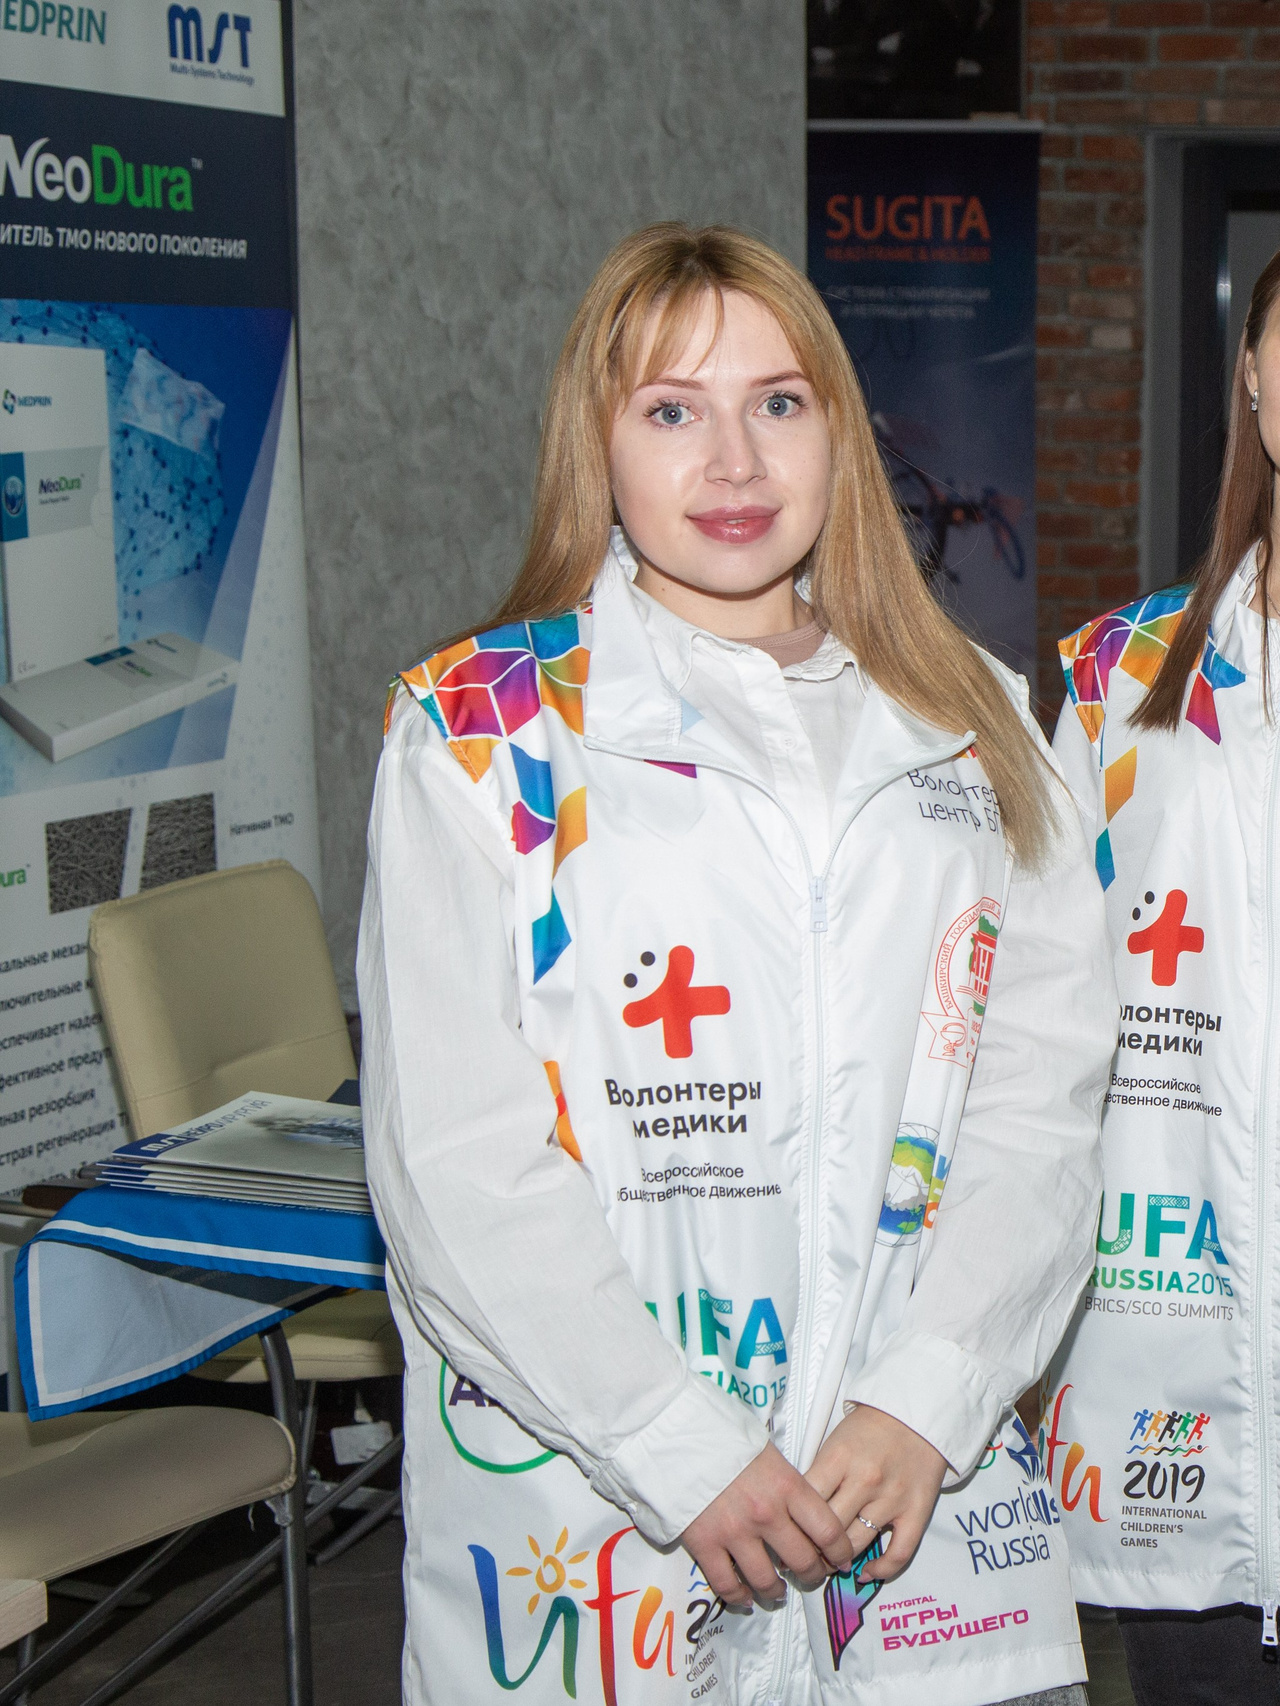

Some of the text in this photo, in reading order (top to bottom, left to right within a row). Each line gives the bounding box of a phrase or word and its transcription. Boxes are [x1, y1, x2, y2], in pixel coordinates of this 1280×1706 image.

[0, 0, 107, 46] EDPRIN
[825, 194, 991, 241] SUGITA
[0, 223, 248, 260] ИТЕЛЬ ТМО НОВОГО ПОКОЛЕНИЯ
[918, 801, 981, 833] центр
[1120, 1004, 1222, 1036] лонтеры
[604, 1078, 763, 1111] Волонтеры
[1111, 1073, 1202, 1095] Всероссийское
[632, 1112, 749, 1140] медики
[641, 1162, 745, 1185] Всероссийское
[708, 1180, 783, 1200] движение
[1084, 1295, 1235, 1322] BRICS/SCO SUMMITS
[1123, 1459, 1206, 1504] 2019
[1121, 1505, 1208, 1520] INTERNATIONAL
[966, 1524, 1051, 1575] Russia
[1120, 1537, 1159, 1549] GAMES
[878, 1595, 938, 1613] PHYGITAL
[880, 1603, 959, 1632] ИГРЫ
[882, 1609, 1031, 1652] БУДУЩЕГО
[690, 1673, 719, 1699] GAMES
